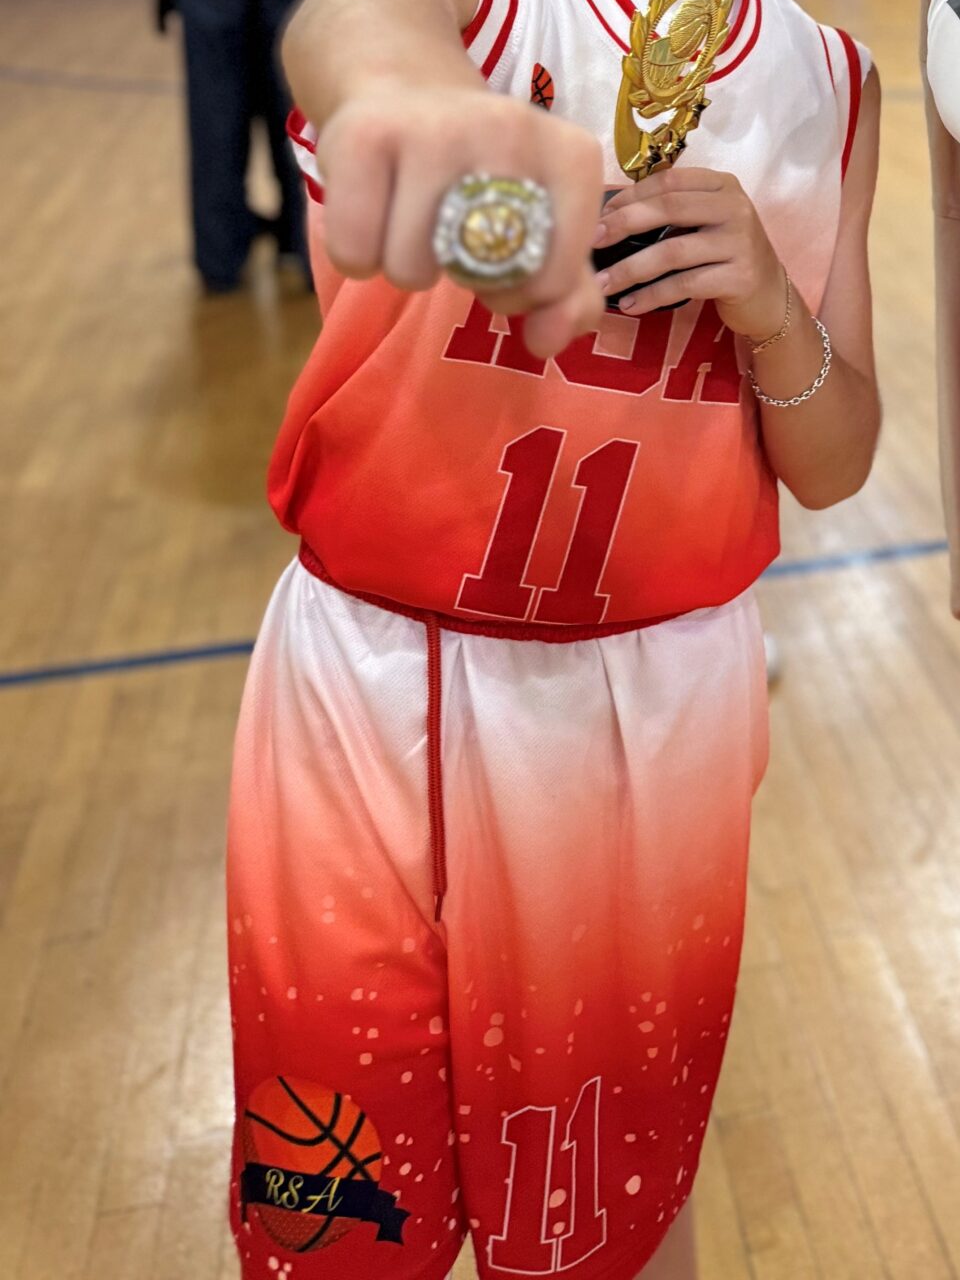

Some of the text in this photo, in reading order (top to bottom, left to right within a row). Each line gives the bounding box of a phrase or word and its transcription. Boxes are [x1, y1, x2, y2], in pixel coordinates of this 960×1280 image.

[454, 425, 640, 625] 11
[265, 1168, 343, 1213] RSA
[488, 1076, 607, 1275] 11
